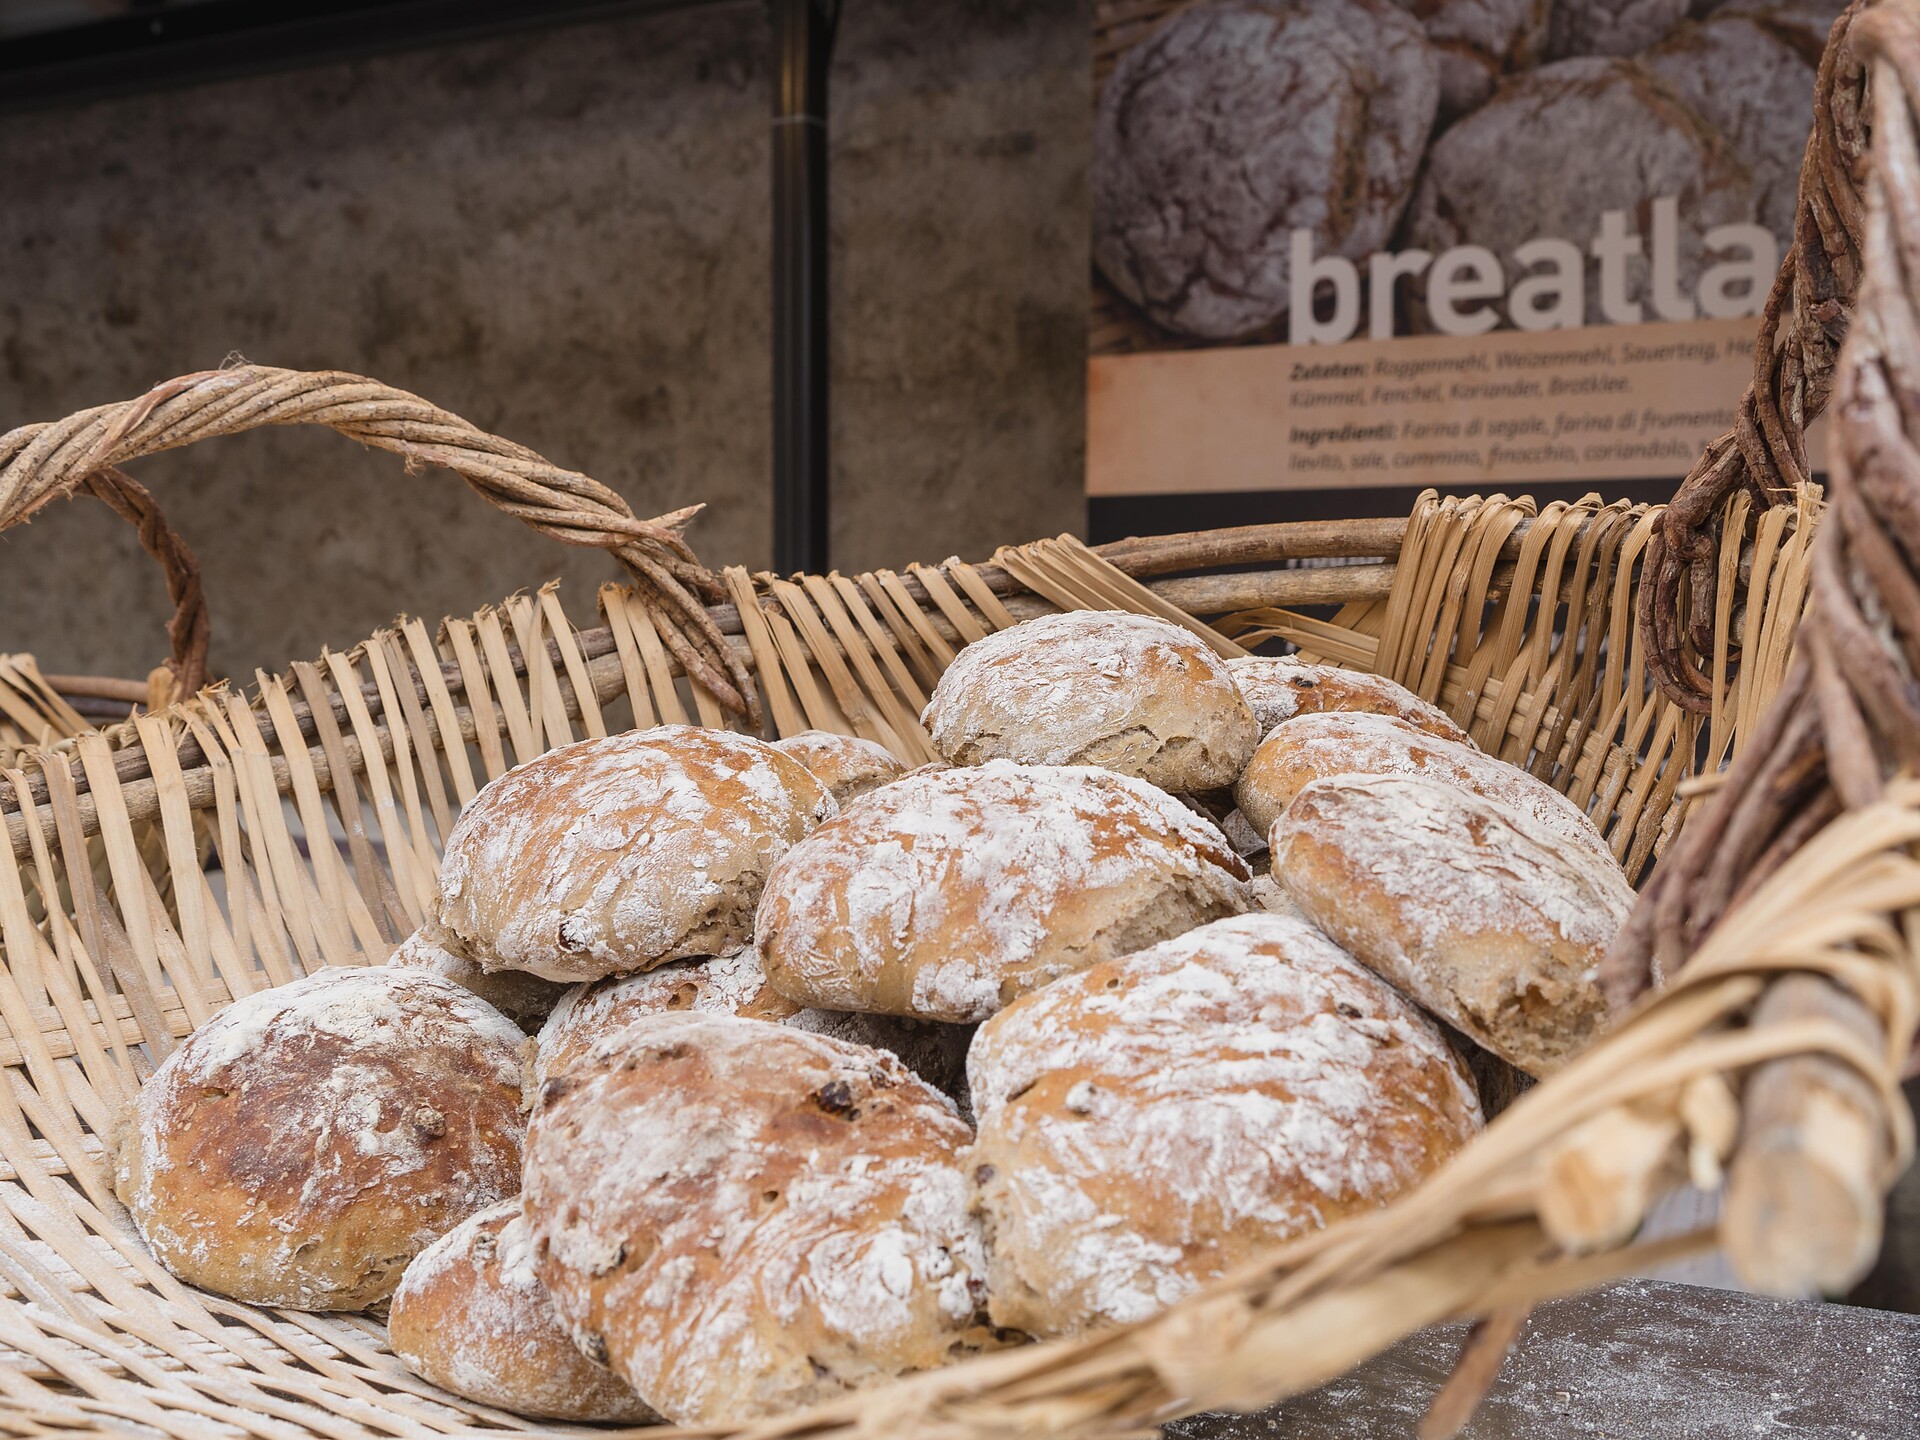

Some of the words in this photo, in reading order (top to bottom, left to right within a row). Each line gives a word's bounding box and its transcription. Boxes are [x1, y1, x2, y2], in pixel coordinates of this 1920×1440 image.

[1288, 196, 1778, 345] breatla
[1289, 363, 1368, 382] Zutaten:
[1372, 353, 1489, 380] Roggenmehl,
[1496, 344, 1615, 369] Weizenmehl,
[1621, 340, 1719, 365] Sauerteig,
[1371, 382, 1444, 404] Fenchel,
[1449, 377, 1543, 401] Koriander,
[1547, 373, 1632, 397] Brotklee.
[1288, 420, 1396, 448] Ingredienti:
[1401, 419, 1461, 439] Farina
[1465, 416, 1483, 437] di
[1487, 414, 1548, 441] segale,
[1552, 410, 1613, 438] farina
[1617, 408, 1637, 429] di
[1289, 452, 1345, 472] lievito,
[1349, 449, 1388, 470] sale,
[1485, 440, 1579, 470] finocchio,
[1583, 437, 1692, 463] coriandolo,
